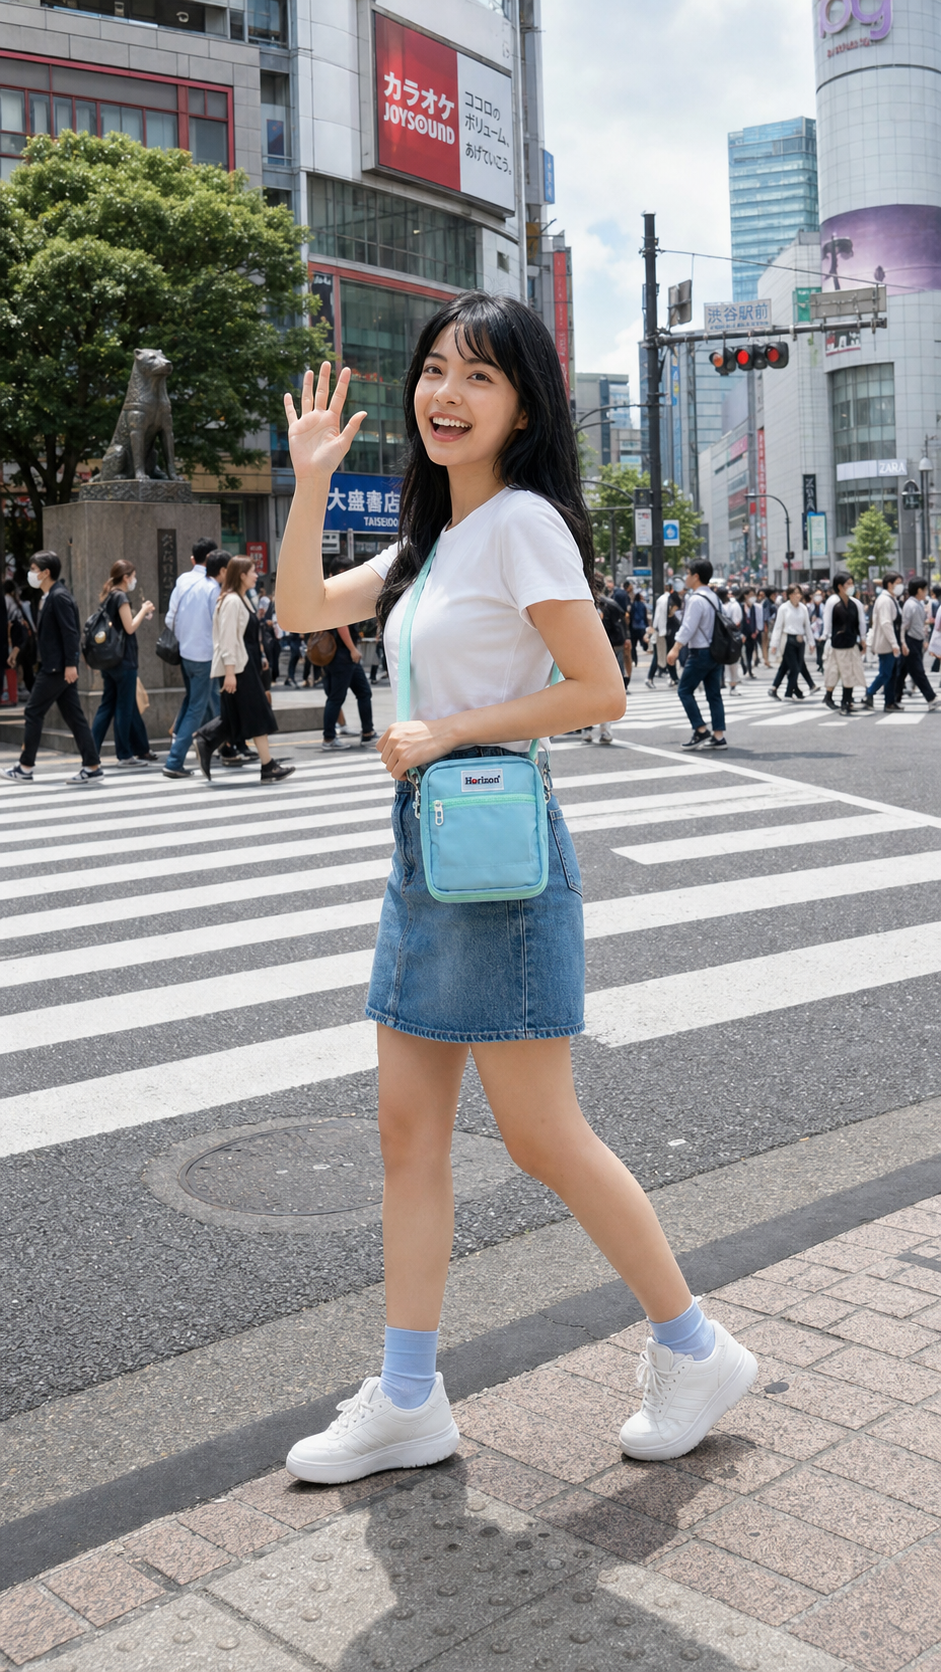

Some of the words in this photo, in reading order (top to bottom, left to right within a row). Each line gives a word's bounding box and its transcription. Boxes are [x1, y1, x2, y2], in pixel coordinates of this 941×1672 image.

[383, 71, 455, 120] カラオケ
[465, 91, 501, 121] ココロの
[383, 102, 456, 145] JOYSOUND
[465, 142, 512, 175] あげていこう。
[879, 462, 905, 474] ZARA
[465, 775, 500, 785] Horizon
